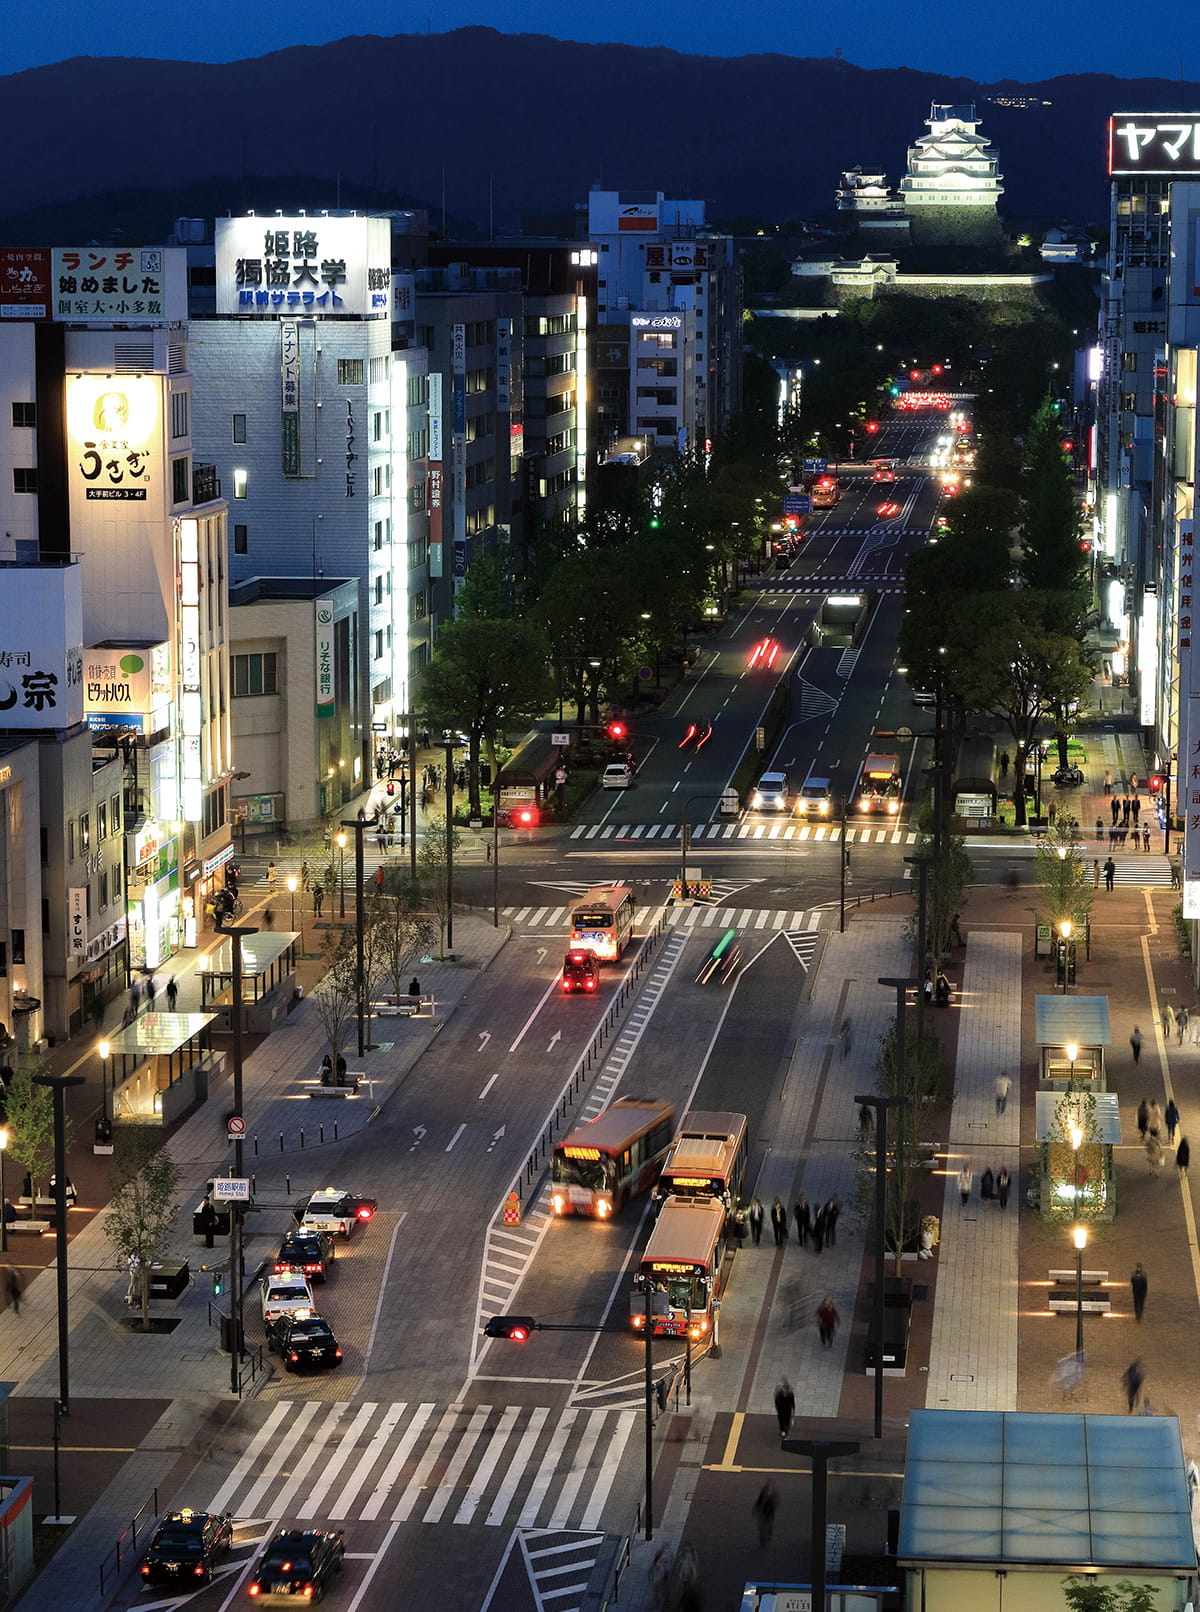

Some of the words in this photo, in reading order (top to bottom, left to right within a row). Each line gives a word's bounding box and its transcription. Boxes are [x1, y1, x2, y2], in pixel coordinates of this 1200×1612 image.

[265, 229, 319, 259] 姫路
[62, 252, 134, 271] ランチ
[235, 258, 347, 288] 獨協大学
[58, 275, 161, 294] 始めました
[58, 300, 162, 315] 個室大・小多数
[238, 290, 344, 307] 駅前サテライト
[284, 327, 296, 406] テナント募集
[345, 398, 358, 498] しらさぎビル
[79, 441, 150, 484] うさぎ
[88, 490, 122, 499] 大手前ビル
[123, 490, 144, 499] 3・4F
[455, 547, 465, 571] TBC
[88, 664, 117, 680] 賃貸・売買
[319, 641, 332, 695] りそな銀行
[88, 682, 132, 702] ピタットハウス
[73, 914, 83, 949] すし宗
